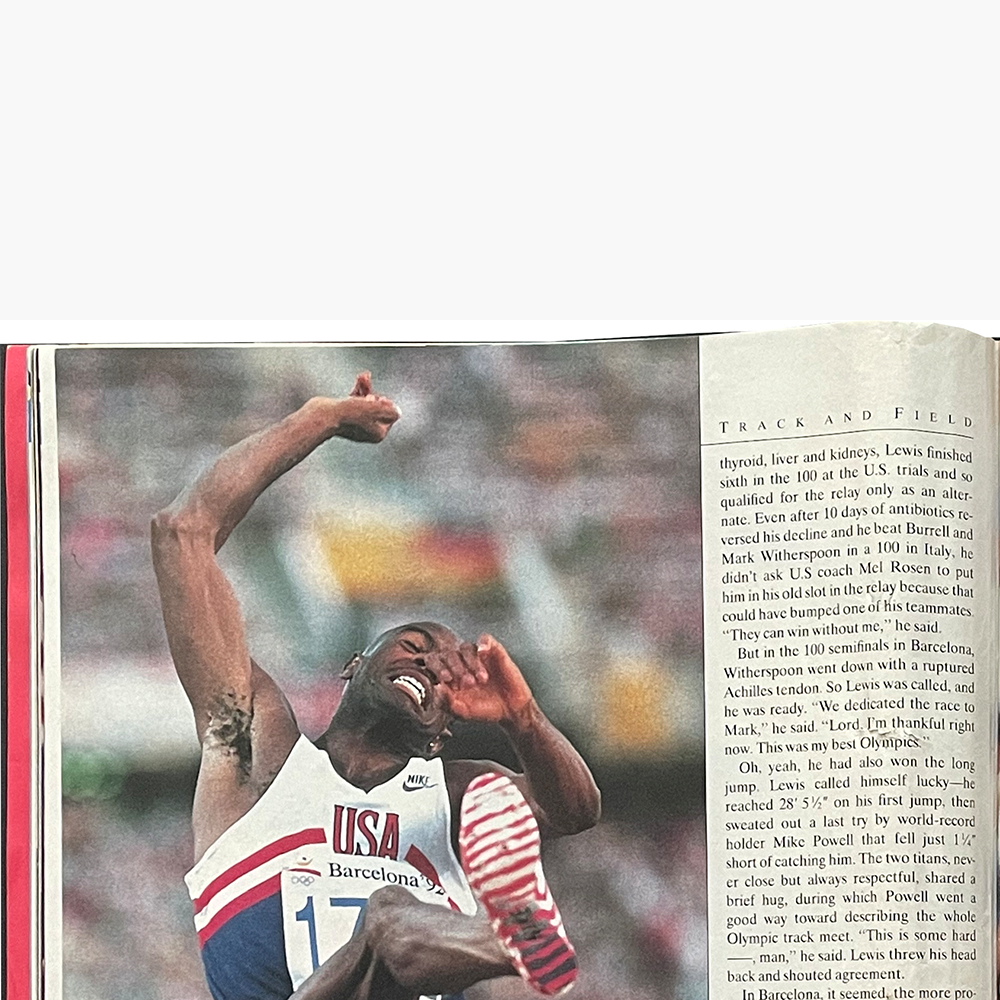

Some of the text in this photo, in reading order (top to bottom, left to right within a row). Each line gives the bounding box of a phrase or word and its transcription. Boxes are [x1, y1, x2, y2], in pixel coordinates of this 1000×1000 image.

[719, 407, 973, 434] TRACK AND FIELD
[720, 444, 972, 472] thyroid, liver and kidneys, Lewis finished
[721, 483, 972, 511] qualified for the relay only as an alter-
[722, 542, 973, 565] Mark Witherspoon in a 100 in Italy, he
[722, 597, 974, 622] could have bumped one of his teammates.
[724, 658, 974, 680] Witherspoon went down with a ruptured
[724, 706, 738, 717] he
[743, 707, 765, 716] was
[770, 702, 808, 717] ready.
[844, 698, 904, 712] dedicated
[910, 698, 930, 710] the
[935, 702, 960, 711] race
[964, 702, 975, 713] to
[725, 782, 759, 796] jump.
[770, 778, 805, 791] Lewis
[815, 776, 850, 789] called
[861, 774, 907, 788] himself
[333, 805, 399, 861] USA
[726, 857, 757, 869] short
[760, 855, 772, 868] of
[775, 854, 826, 869] catching
[829, 853, 856, 865] him.
[859, 853, 882, 864] The
[886, 854, 909, 864] two
[913, 852, 950, 866] titans,
[727, 932, 778, 947] Olympic
[784, 931, 814, 943] track
[820, 932, 853, 942] meet.
[899, 930, 909, 941] is
[914, 932, 947, 943] some
[952, 929, 976, 942] hard
[727, 969, 905, 982] back and shouted agreement.
